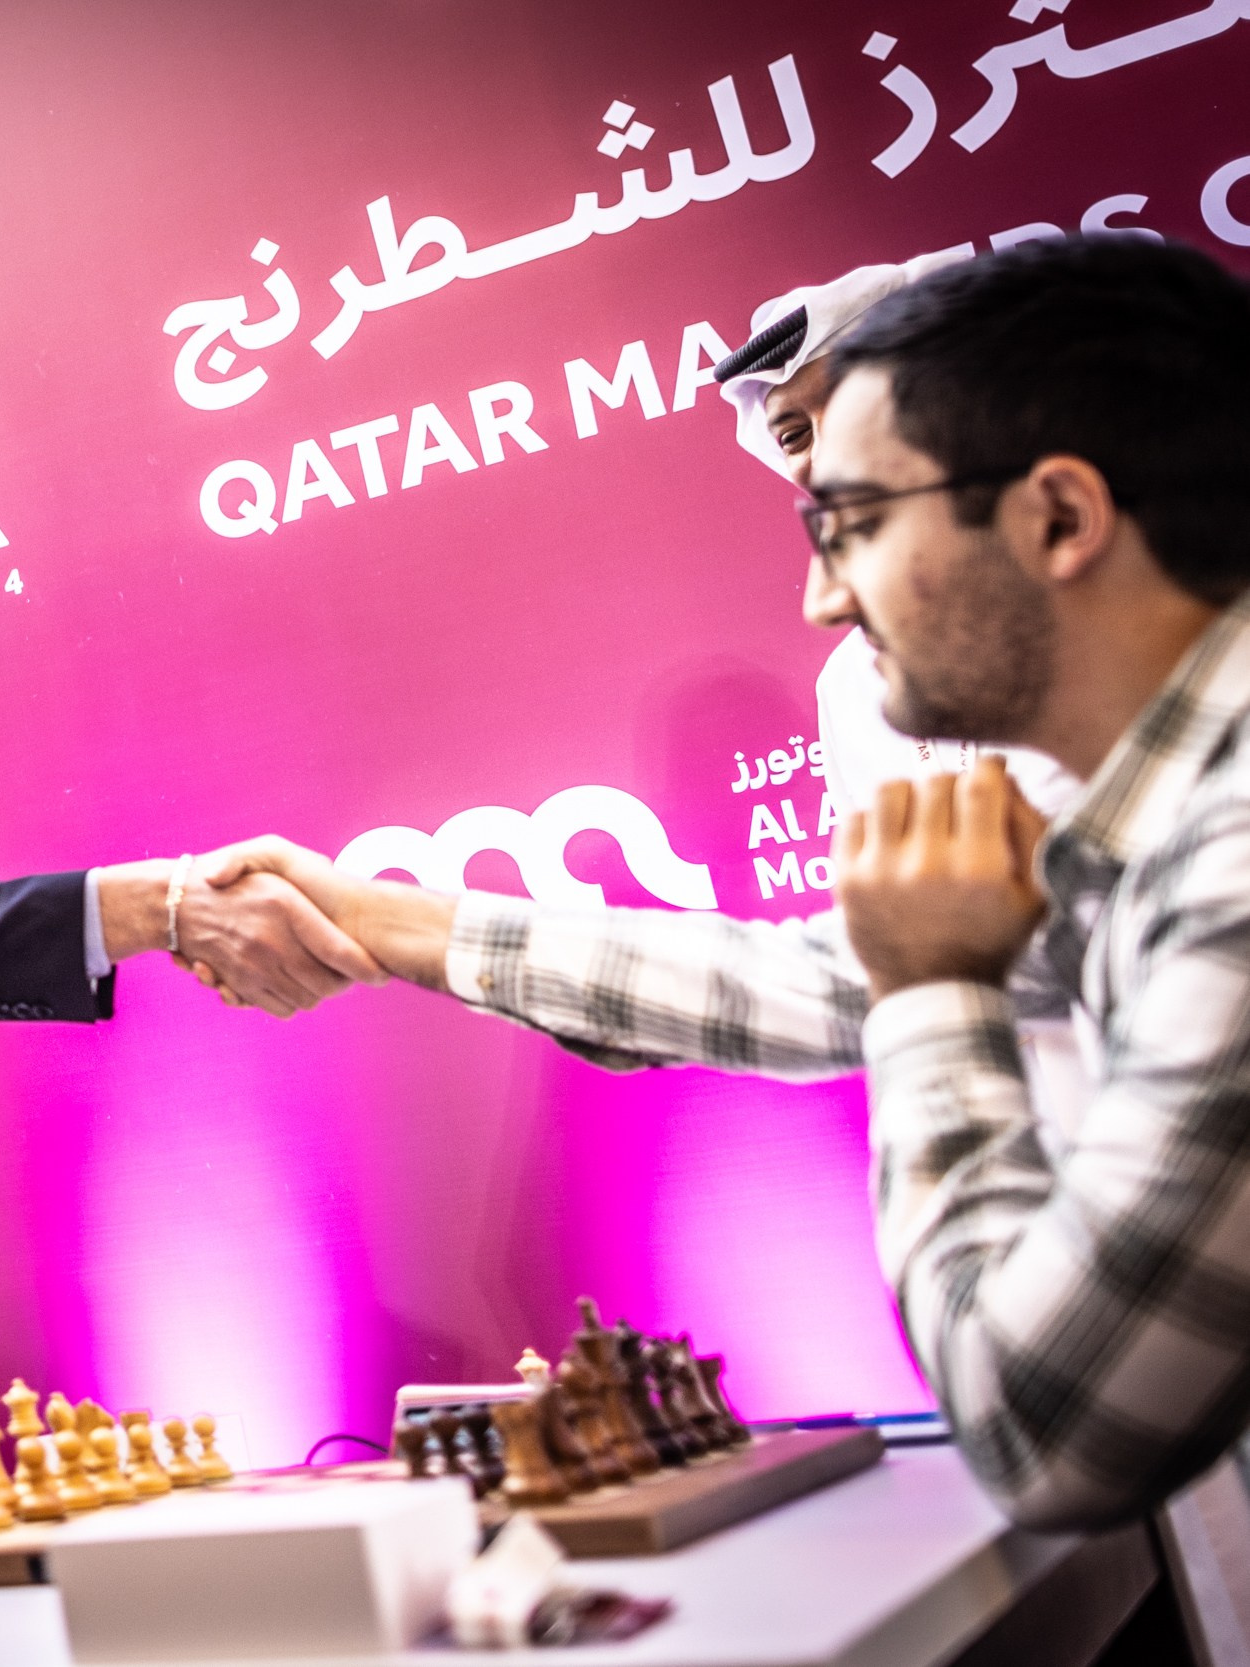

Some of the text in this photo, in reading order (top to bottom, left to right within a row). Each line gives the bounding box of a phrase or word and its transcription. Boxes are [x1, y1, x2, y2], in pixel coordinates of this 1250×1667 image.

[163, 54, 817, 411] للشطرنج
[199, 378, 550, 539] QATAR
[748, 799, 807, 850] Al
